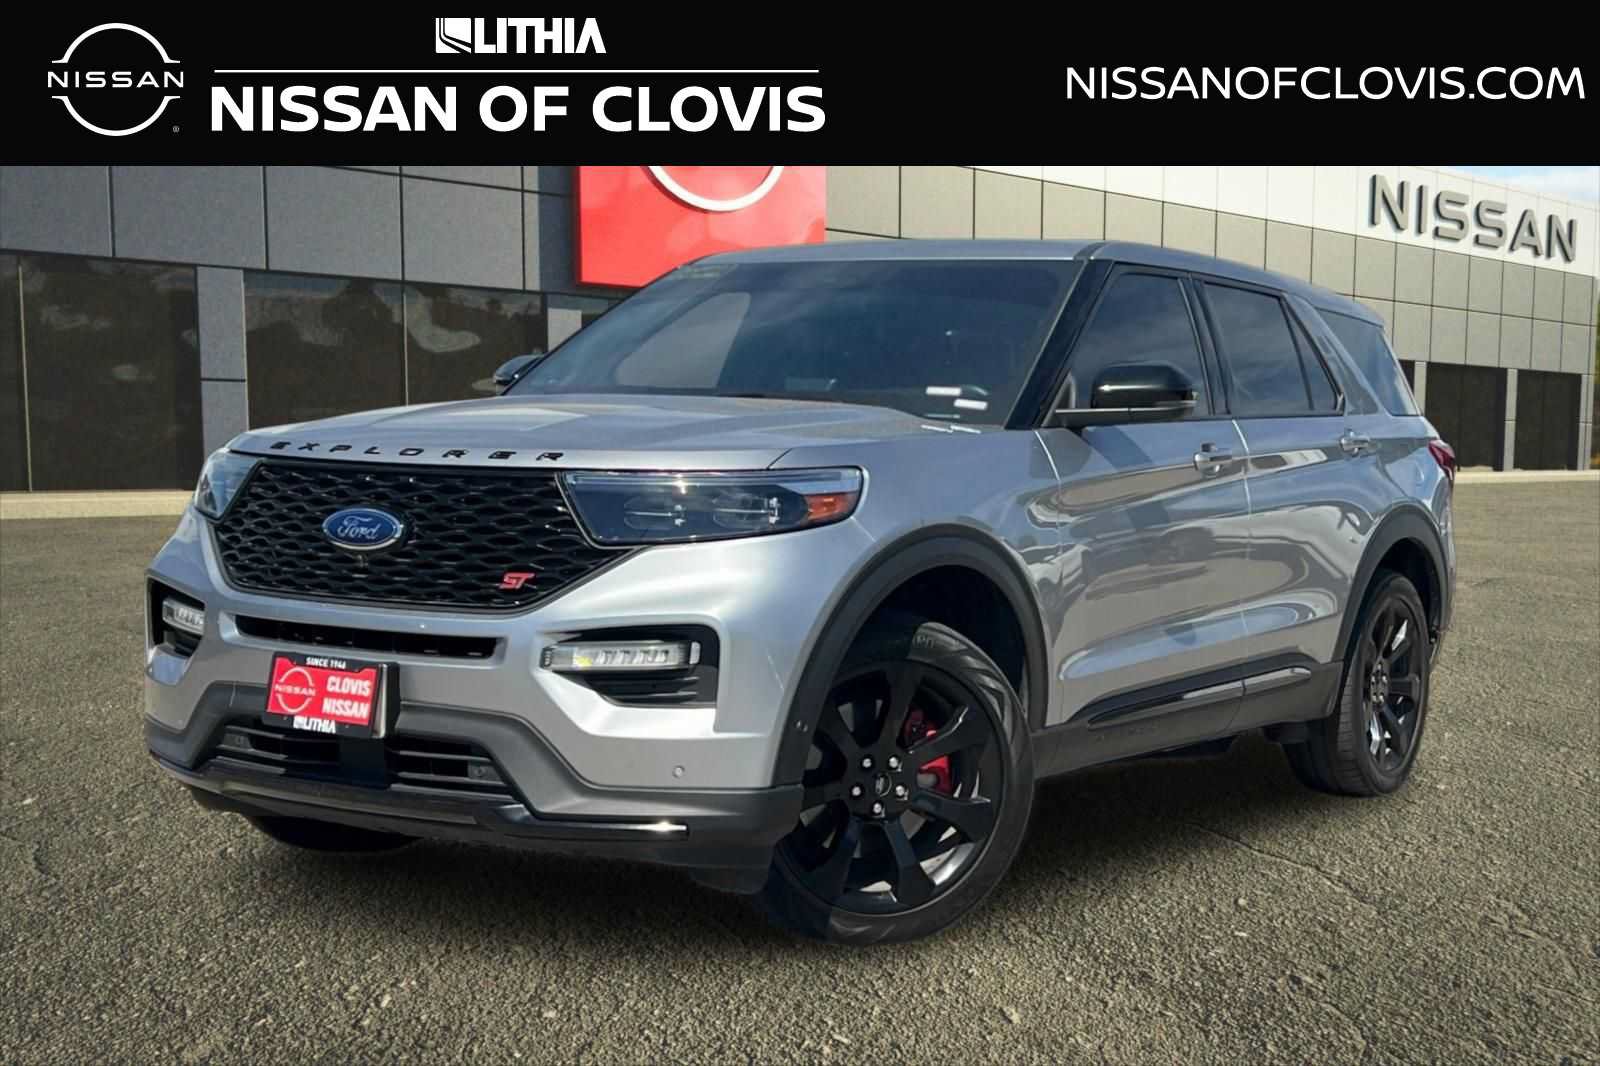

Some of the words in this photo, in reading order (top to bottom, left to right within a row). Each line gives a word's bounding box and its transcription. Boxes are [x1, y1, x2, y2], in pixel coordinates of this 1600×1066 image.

[1370, 174, 1577, 262] NISSAN
[270, 441, 564, 462] EXPLORER
[337, 516, 379, 540] Ford
[500, 572, 535, 589] ST
[306, 657, 328, 668] SINCE
[275, 684, 316, 697] NISSAN
[327, 676, 370, 697] CLOVIS
[322, 698, 369, 719] NISSAN
